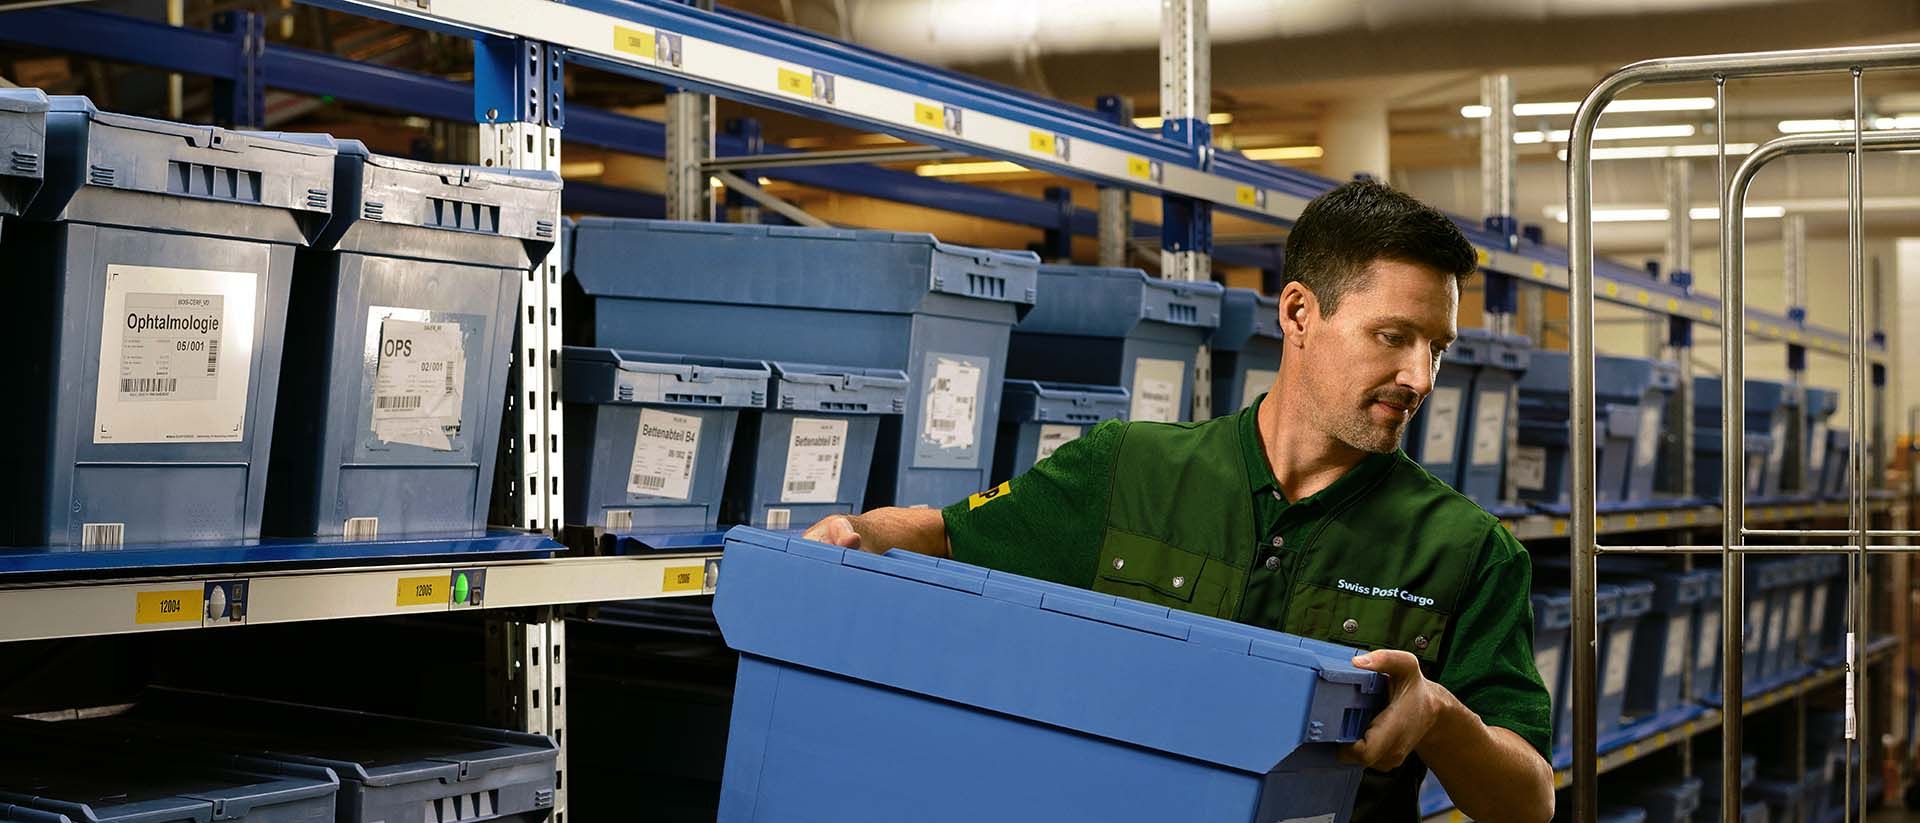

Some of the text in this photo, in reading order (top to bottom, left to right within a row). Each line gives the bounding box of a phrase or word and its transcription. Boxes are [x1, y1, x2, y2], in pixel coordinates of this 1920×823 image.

[127, 313, 219, 334] Ophtalmologie
[176, 341, 204, 351] 05/001
[384, 339, 412, 357] OPS
[421, 362, 443, 371] 02/001
[642, 424, 696, 442] Bettenabteil B4
[416, 584, 432, 597] 12005
[1337, 579, 1434, 606] Swiss Post Cargo
[160, 600, 180, 613] 12004
